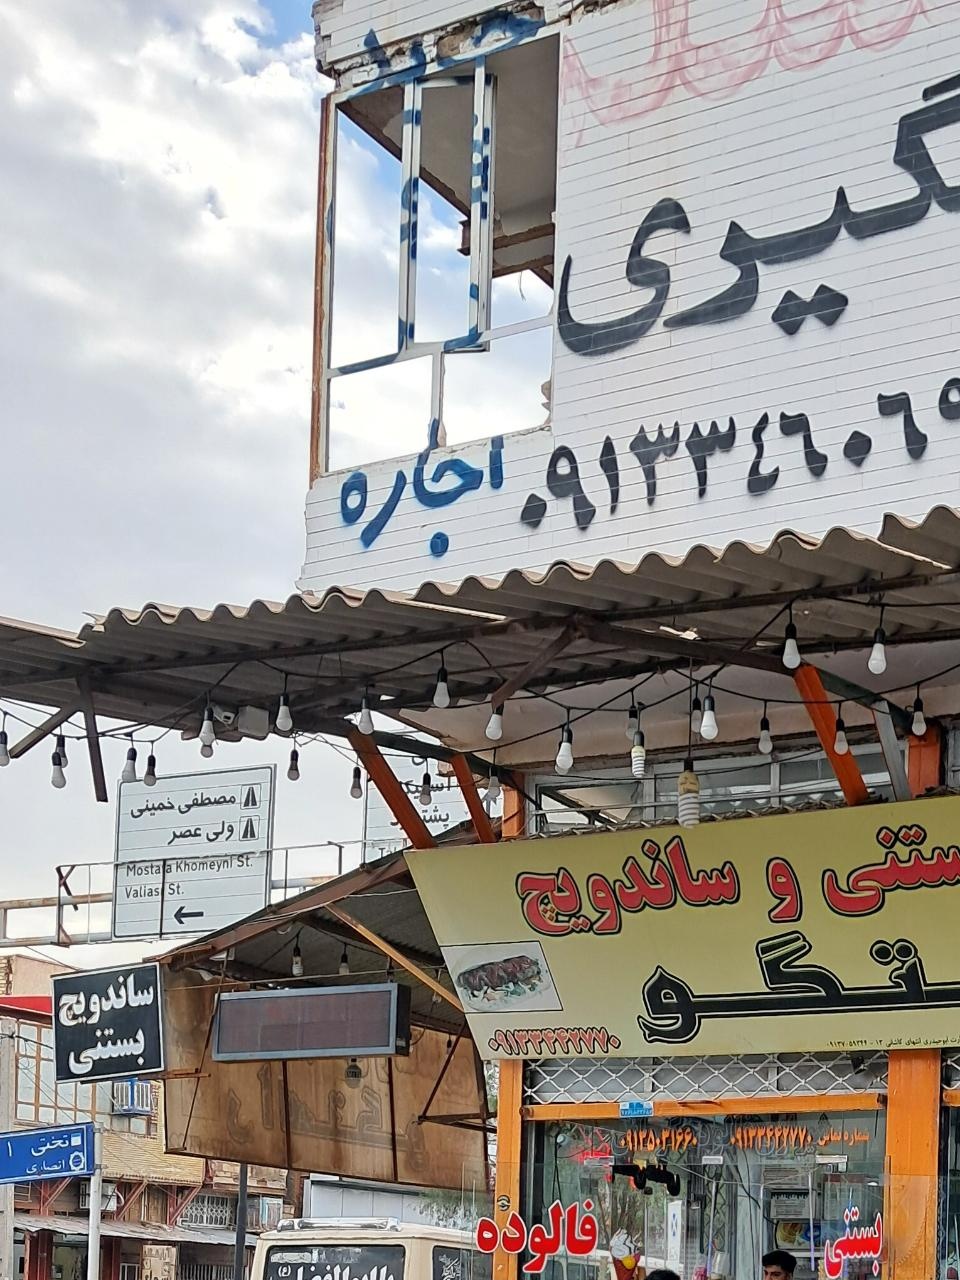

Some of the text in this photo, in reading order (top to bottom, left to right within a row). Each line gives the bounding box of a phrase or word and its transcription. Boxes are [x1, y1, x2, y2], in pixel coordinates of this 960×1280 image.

[340, 417, 505, 557] اجاره
[131, 792, 236, 818] مصطفی خمینی
[168, 821, 234, 845] ولی عصر
[126, 854, 253, 877] Mostaa Khomeyni St.
[516, 834, 740, 936] ساندویچ
[766, 857, 803, 923] و
[125, 883, 185, 899] Valias St.
[57, 973, 154, 1027] ساندویچ
[68, 1027, 146, 1074] بستنی
[31, 1135, 69, 1156] تختی
[475, 1198, 599, 1274] فالوده
[824, 1204, 884, 1279] بستنی
